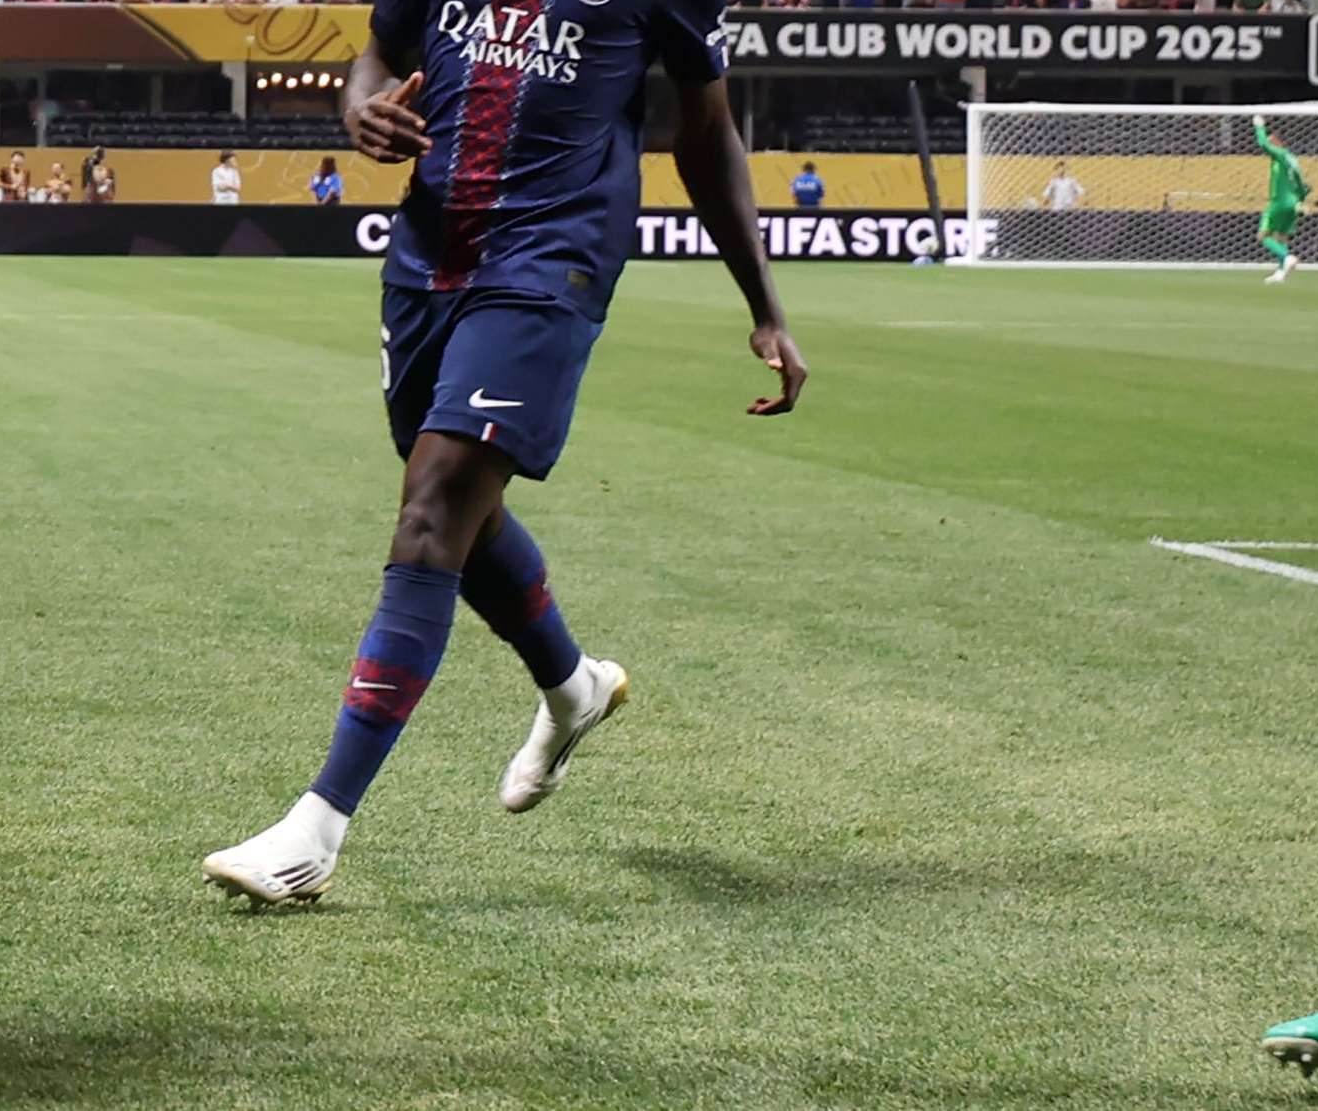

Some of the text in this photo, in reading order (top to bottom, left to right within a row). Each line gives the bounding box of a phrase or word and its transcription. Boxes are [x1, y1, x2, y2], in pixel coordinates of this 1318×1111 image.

[438, 0, 584, 59] QATAR
[723, 22, 770, 57] FA
[776, 22, 886, 58] CLUB
[895, 23, 1051, 60] WORLD
[1060, 25, 1147, 60] CUP
[459, 40, 579, 84] AIRWAYS
